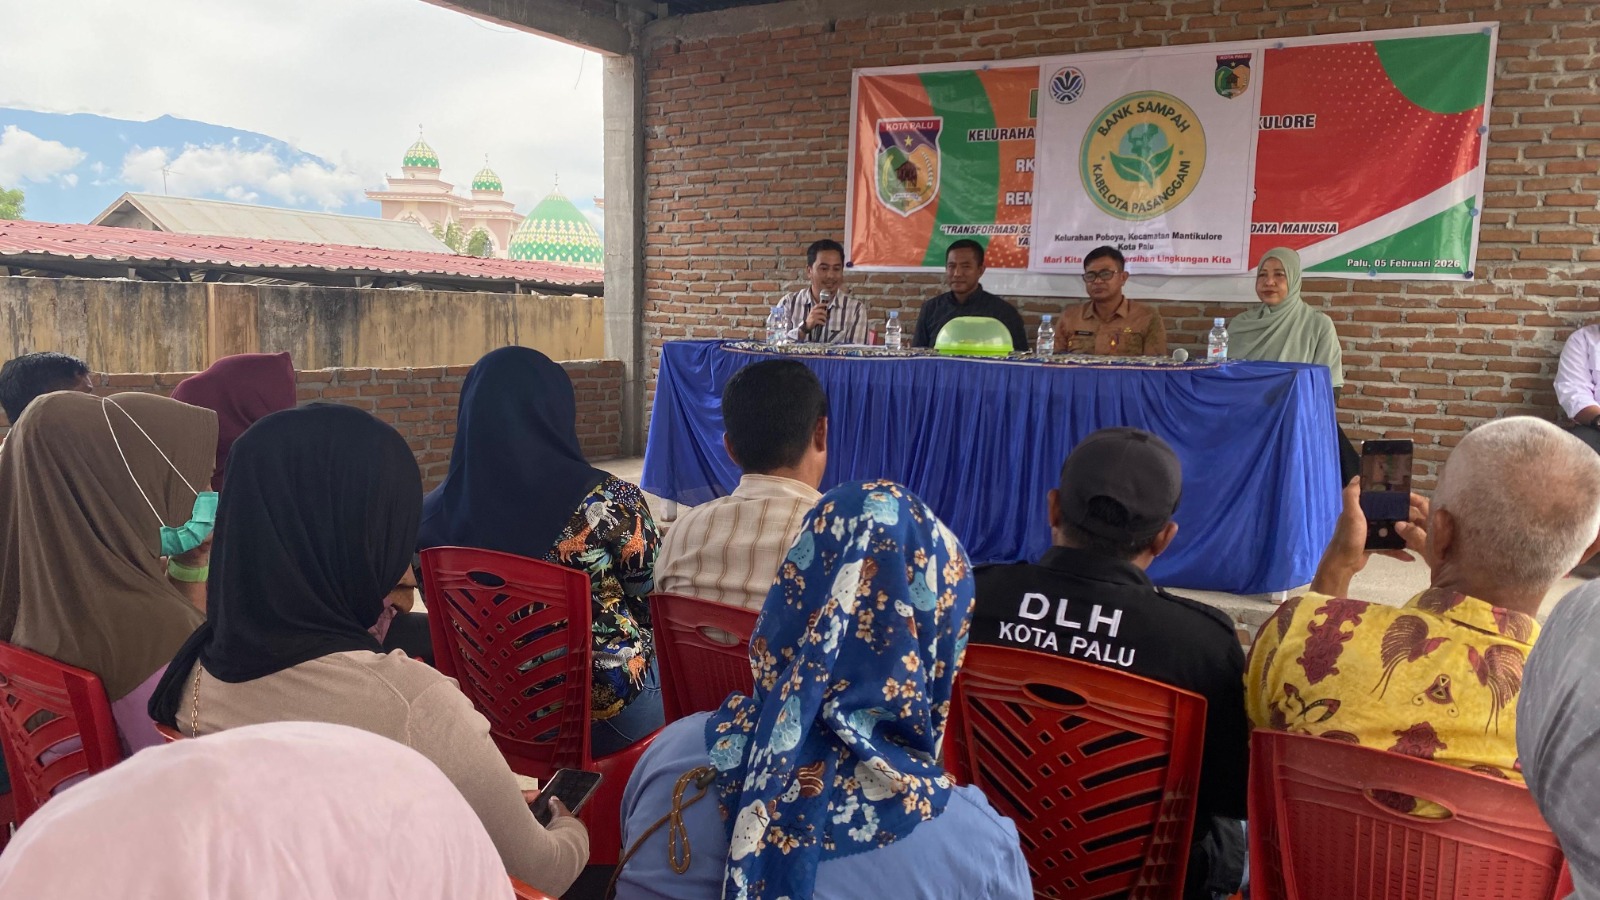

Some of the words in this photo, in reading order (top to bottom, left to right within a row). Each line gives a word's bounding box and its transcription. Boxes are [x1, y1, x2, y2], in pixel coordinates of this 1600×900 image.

[1097, 104, 1133, 136] BANK
[1136, 101, 1191, 133] SAMPAH
[886, 123, 909, 131] KOTA
[1093, 163, 1129, 212] KABELOTA
[1131, 160, 1191, 213] PASANGGANI
[1251, 223, 1278, 233] DAYA
[1281, 222, 1337, 233] MANUSIA
[1095, 233, 1126, 242] Poboya,
[1172, 232, 1222, 241] Mantikulore
[1157, 255, 1209, 264] Lingkungan
[1211, 256, 1232, 264] Kita
[1347, 258, 1371, 268] Palu,
[1374, 259, 1387, 267] 05
[1389, 259, 1431, 268] Februari
[1434, 259, 1461, 268] 2026
[1018, 592, 1123, 638] DLH
[998, 621, 1058, 652] KOTA
[1069, 635, 1136, 667] PALU
